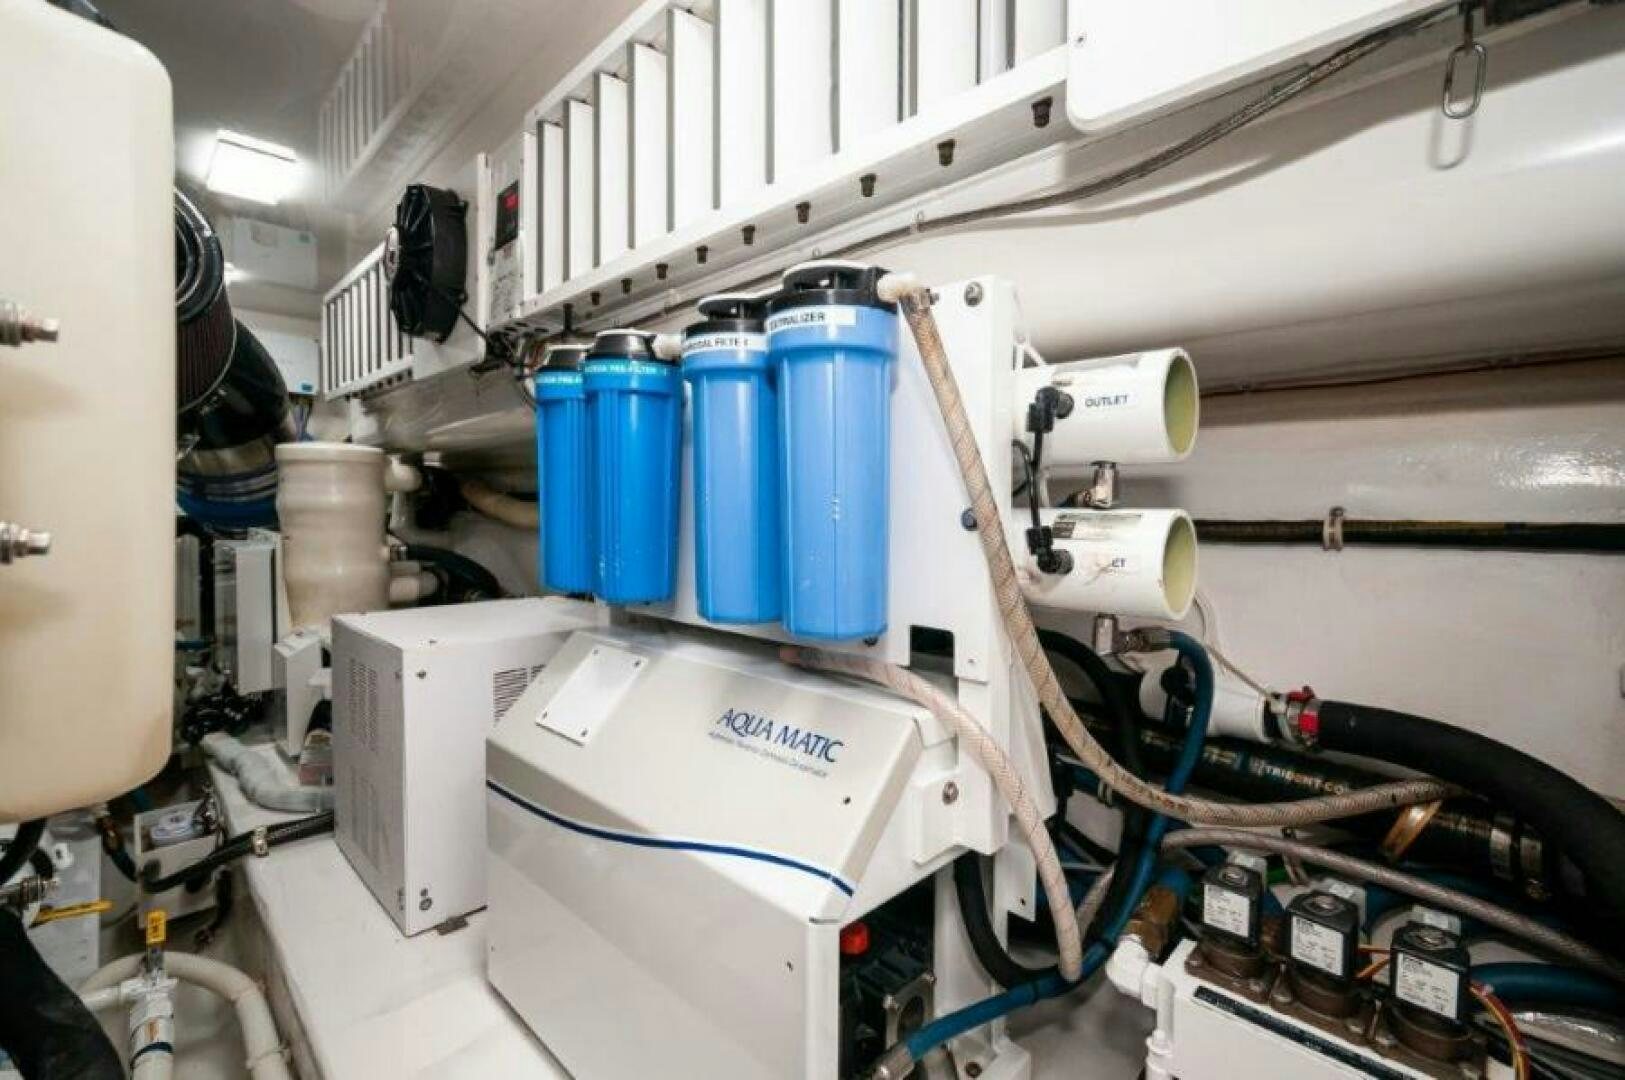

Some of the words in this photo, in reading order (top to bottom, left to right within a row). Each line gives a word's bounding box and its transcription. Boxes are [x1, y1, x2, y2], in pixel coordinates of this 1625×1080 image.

[1084, 394, 1128, 407] OUTLET
[716, 707, 774, 741] AQUA
[774, 725, 844, 763] MATIC
